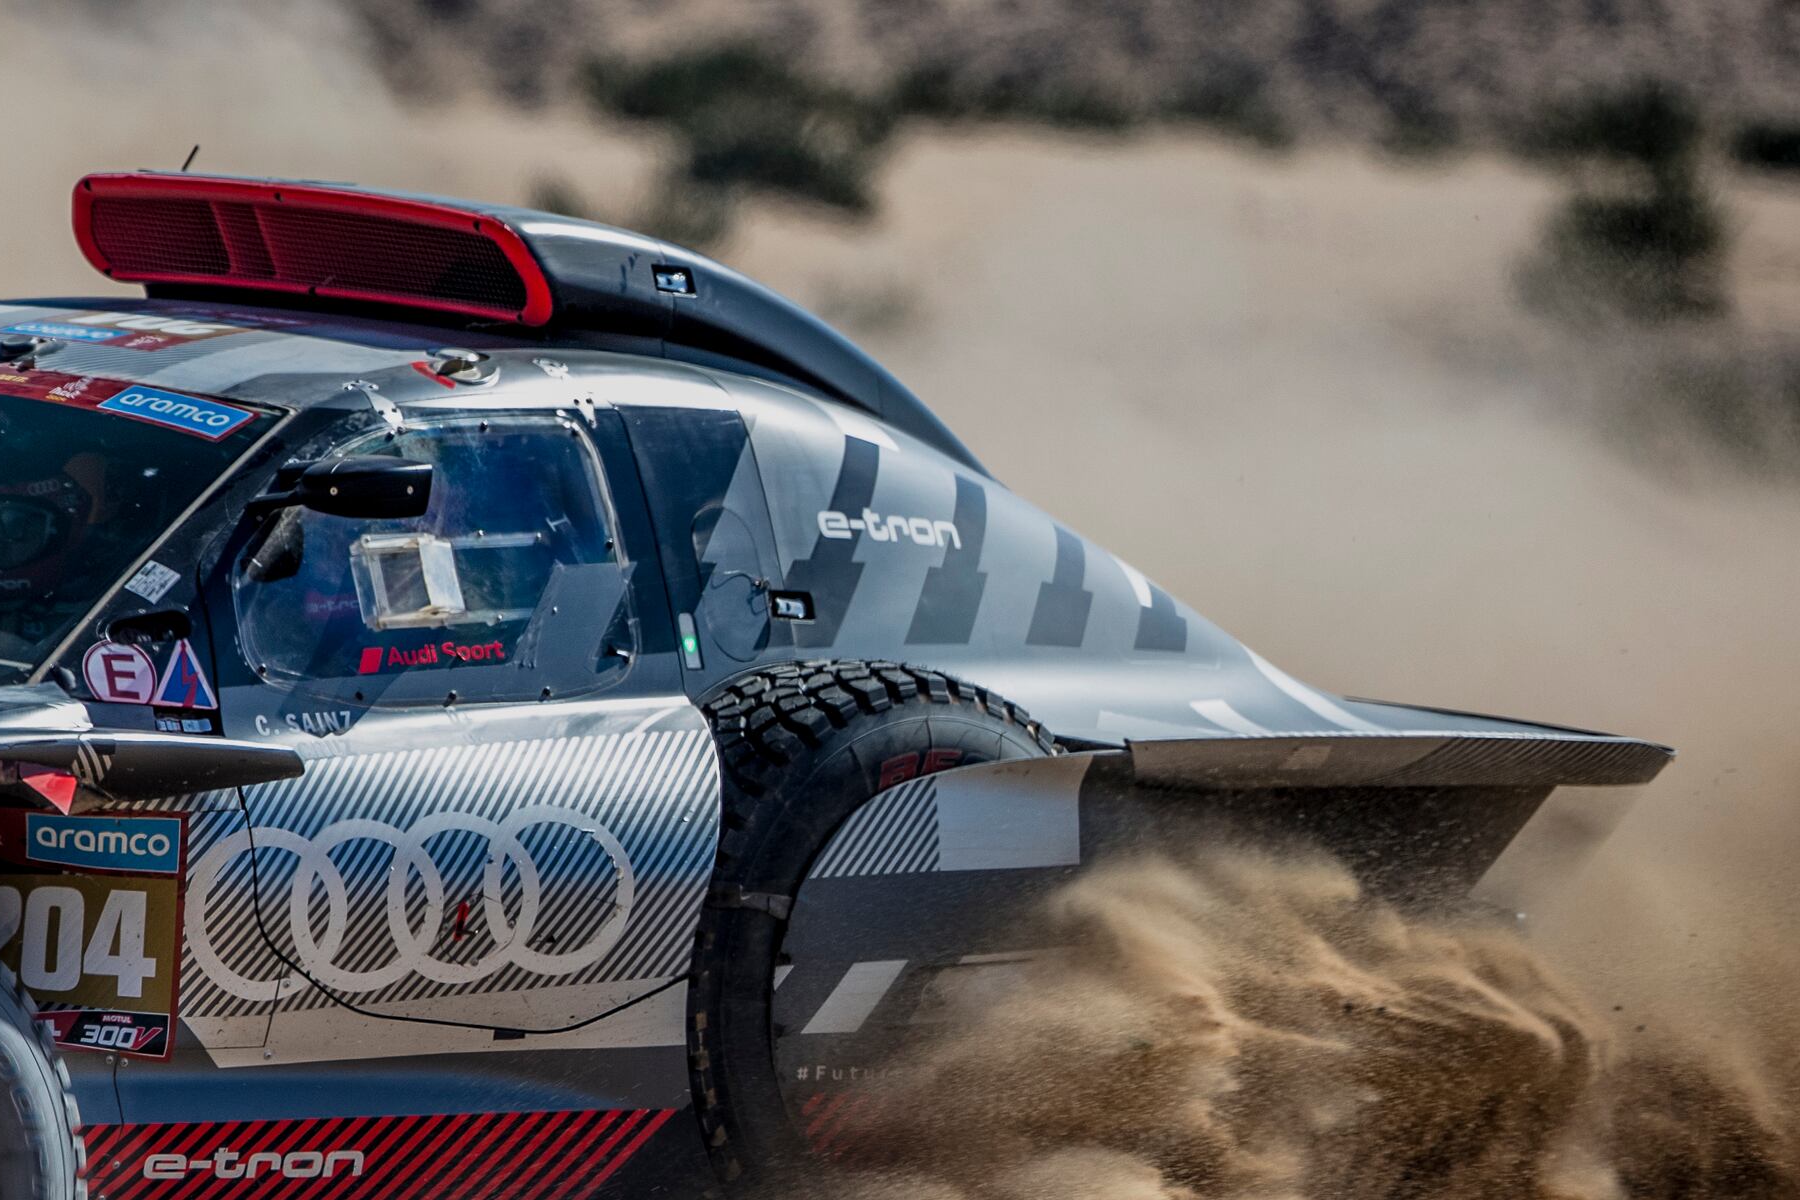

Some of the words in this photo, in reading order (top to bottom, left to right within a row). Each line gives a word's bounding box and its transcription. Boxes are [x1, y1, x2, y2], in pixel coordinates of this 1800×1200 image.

[119, 392, 231, 428] aramco
[817, 507, 962, 550] e-tron
[387, 644, 438, 667] Audi
[441, 640, 505, 662] Sport
[101, 654, 140, 700] E
[255, 714, 280, 737] C.
[36, 826, 170, 857] aramco
[102, 1015, 131, 1023] MOTUL
[80, 1024, 164, 1050] 300V
[143, 1147, 364, 1179] e-tron
